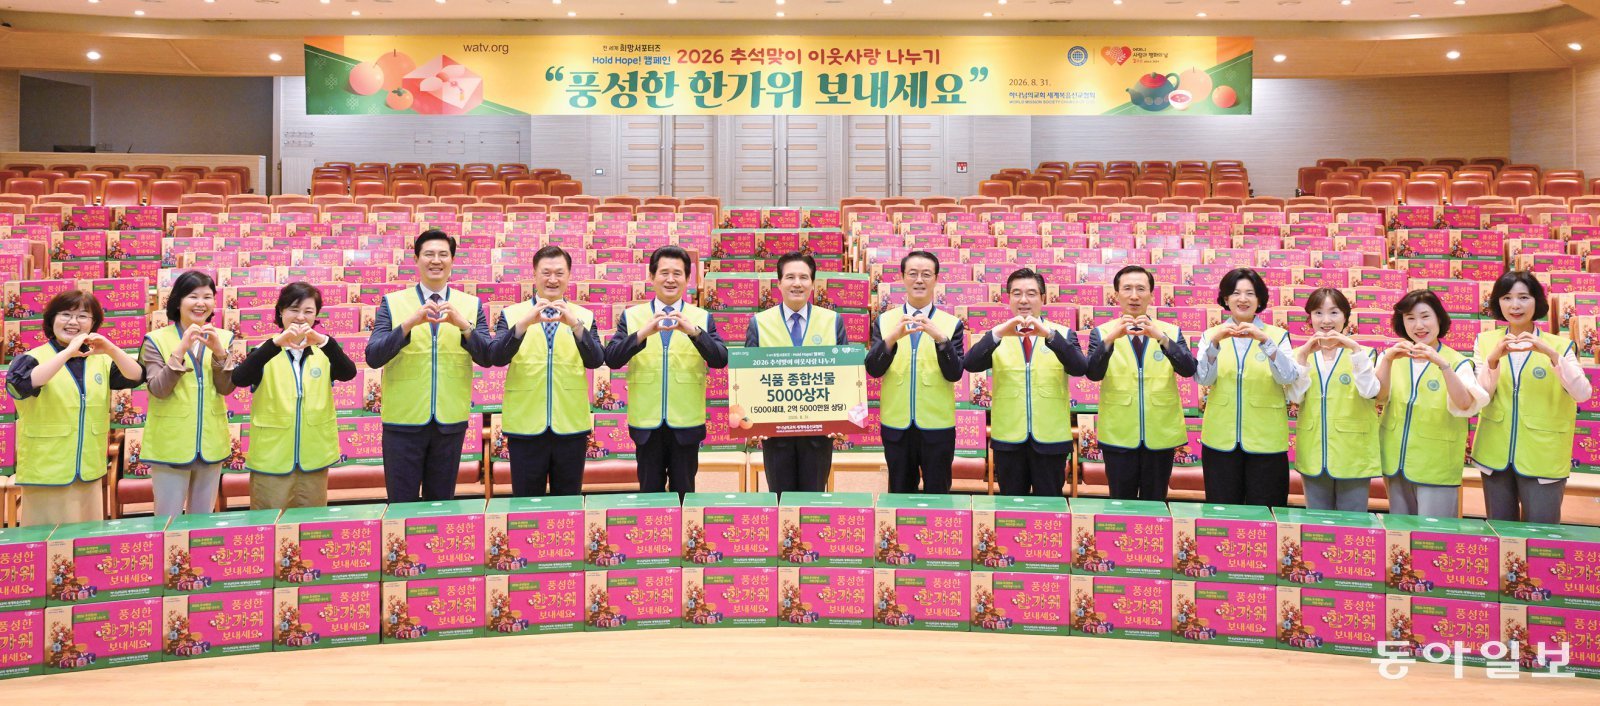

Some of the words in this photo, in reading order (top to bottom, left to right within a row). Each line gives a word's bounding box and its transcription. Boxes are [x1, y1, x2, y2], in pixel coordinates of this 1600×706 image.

[463, 42, 508, 54] watv.org
[620, 44, 661, 52] 희망서포터즈
[615, 56, 641, 66] Hope!
[644, 56, 670, 65] 캠페인
[677, 49, 724, 64] 2026
[730, 48, 801, 65] 추석맞이
[808, 48, 881, 65] 이웃사랑
[887, 48, 940, 65] 나누기
[545, 66, 679, 109] “풍성한
[688, 70, 803, 109] 한가위
[816, 66, 988, 109] 보내세요”
[760, 374, 784, 387] 식품
[787, 372, 835, 386] 종합선물
[767, 387, 830, 402] 5000상자
[800, 404, 830, 412] 5000만원
[546, 518, 574, 529] 풍성한
[645, 514, 672, 525] 풍성한
[741, 515, 769, 524] 풍성한
[837, 515, 865, 524] 풍성한
[934, 517, 962, 527] 풍성한
[1033, 519, 1061, 530] 풍성한
[342, 527, 371, 539] 풍성한
[446, 522, 474, 534] 풍성한
[726, 526, 769, 542] 한가위
[822, 526, 865, 542] 한가위
[1133, 523, 1162, 534] 풍성한
[1237, 528, 1267, 540] 풍성한
[233, 533, 264, 545] 풍성한
[531, 529, 575, 548] 한가위
[630, 525, 672, 544] 한가위
[919, 527, 963, 545] 한가위
[1018, 530, 1062, 548] 한가위
[1344, 534, 1375, 547] 풍성한
[120, 540, 153, 553] 풍성한
[325, 538, 371, 558] 한가위
[430, 533, 475, 553] 한가위
[636, 544, 668, 554] 보내세요
[1118, 534, 1162, 553] 한가위
[1220, 538, 1267, 558] 한가위
[1455, 542, 1488, 555] 풍성한
[216, 544, 264, 566] 한가위
[538, 548, 570, 558] 보내세요
[926, 546, 958, 555] 보내세요
[1024, 549, 1057, 558] 보내세요
[1327, 545, 1376, 566] 한가위
[1574, 550, 1600, 562] 풍성
[102, 552, 153, 574] 한가위
[332, 558, 367, 569] 보내세요
[437, 553, 470, 563] 보내세요
[1124, 553, 1158, 563] 보내세요
[1227, 559, 1262, 569] 보내세요
[1437, 553, 1488, 574] 한가위
[0, 564, 34, 582] 가위
[223, 565, 259, 576] 보내세요
[1334, 565, 1371, 576] 보내세요
[110, 573, 148, 585] 보내세요
[547, 579, 574, 590] 풍성한
[646, 576, 673, 586] 풍성한
[741, 575, 768, 585] 풍성한
[837, 576, 864, 586] 풍성한
[933, 578, 960, 588] 풍성한
[1445, 574, 1483, 585] 보내세요
[447, 584, 475, 595] 풍성한
[1031, 581, 1059, 592] 풍성한
[1133, 585, 1161, 596] 풍성한
[339, 590, 370, 602] 풍성한
[532, 590, 575, 609] 한가위
[631, 586, 673, 605] 한가위
[726, 586, 768, 602] 한가위
[822, 586, 864, 603] 한가위
[918, 588, 961, 606] 한가위
[1236, 591, 1266, 603] 풍성한
[232, 597, 263, 610] 풍성한
[431, 595, 476, 615] 한가위
[1016, 591, 1060, 610] 한가위
[1117, 596, 1162, 615] 한가위
[1344, 598, 1375, 612] 풍성한
[119, 606, 151, 620] 풍성한
[323, 601, 370, 621] 한가위
[538, 609, 570, 619] 보내세요
[637, 605, 669, 615] 보내세요
[924, 607, 956, 616] 보내세요
[1022, 611, 1055, 620] 보내세요
[1220, 601, 1266, 622] 한가위
[1456, 608, 1489, 621] 풍성한
[215, 608, 263, 630] 한가위
[438, 614, 471, 625] 보내세요
[1124, 616, 1157, 626] 보내세요
[1326, 609, 1376, 631] 한가위
[1574, 618, 1600, 631] 풍성
[100, 618, 151, 641] 한가위
[330, 621, 365, 631] 보내세요
[1227, 622, 1262, 632] 보내세요
[1438, 618, 1489, 640] 한가위
[222, 629, 258, 640] 보내세요
[1334, 630, 1370, 642] 보내세요
[0, 632, 33, 650] 가위
[108, 639, 146, 652] 보내세요
